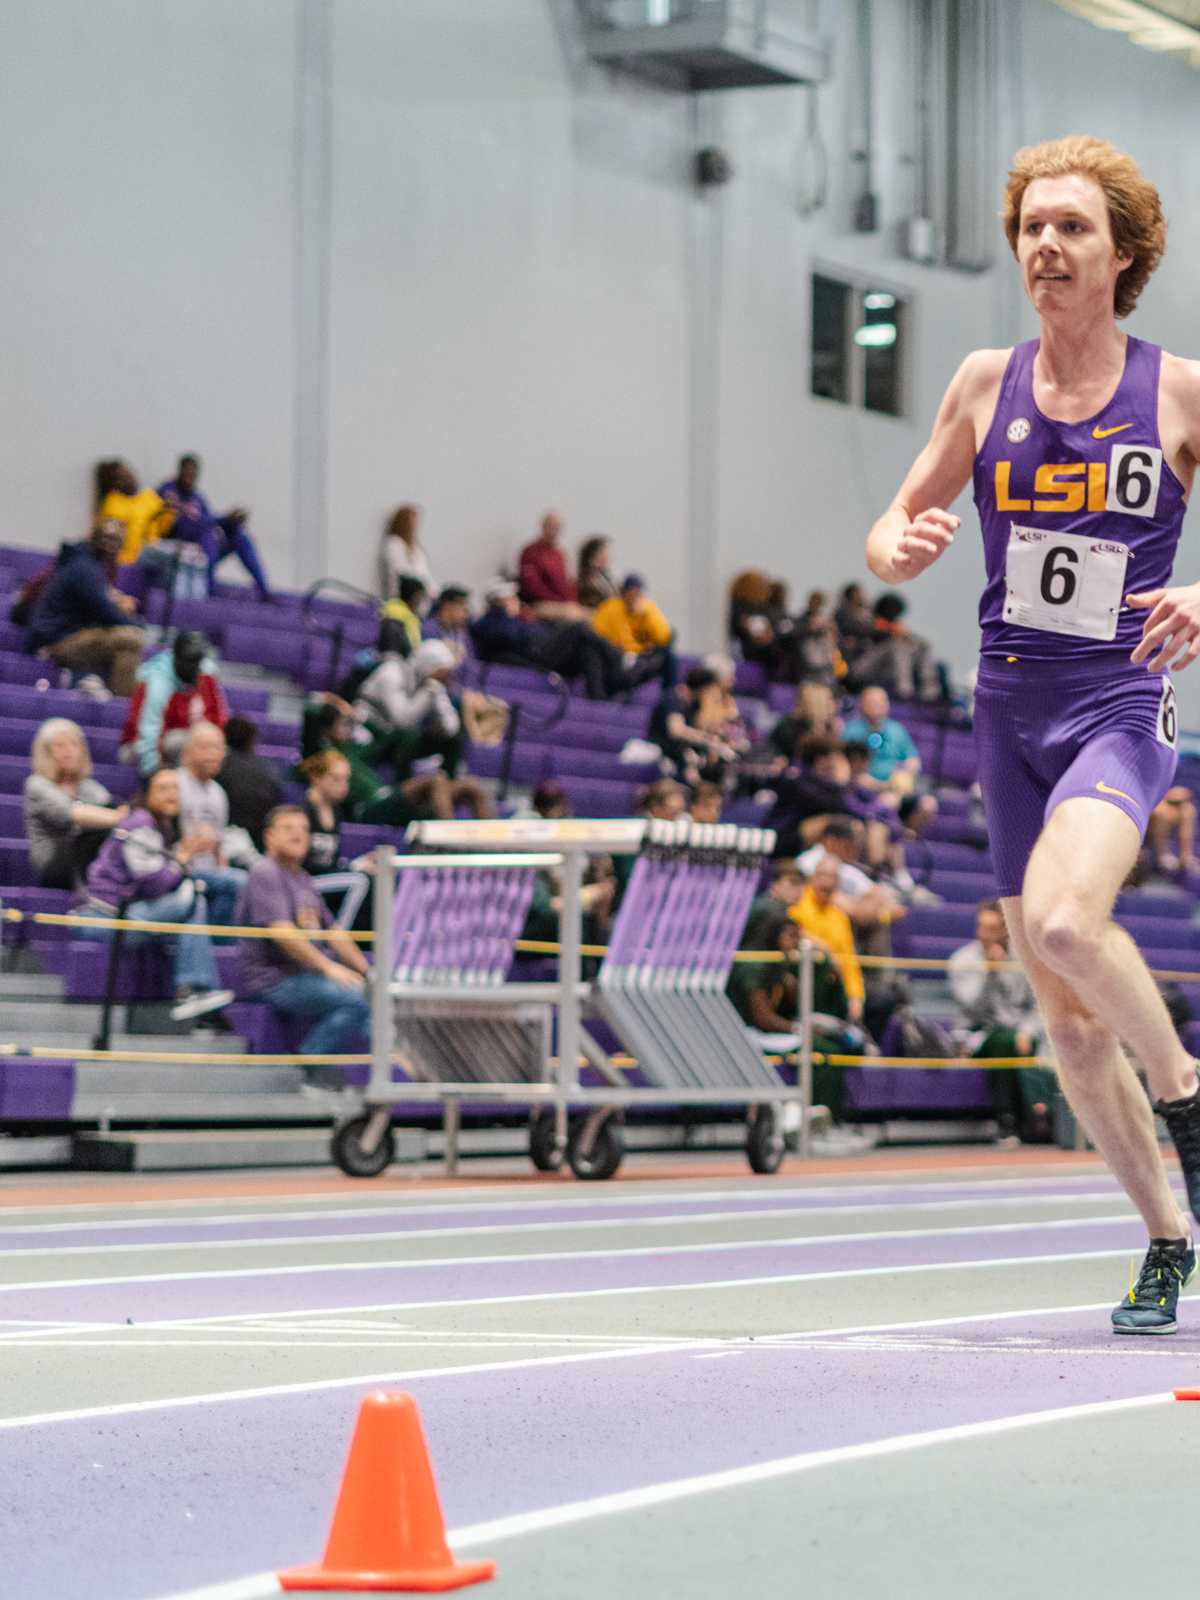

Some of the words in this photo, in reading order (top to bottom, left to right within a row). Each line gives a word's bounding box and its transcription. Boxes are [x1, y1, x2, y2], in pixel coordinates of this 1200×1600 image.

[1115, 451, 1153, 510] 6
[1040, 546, 1079, 605] 6
[1163, 686, 1176, 743] 6
